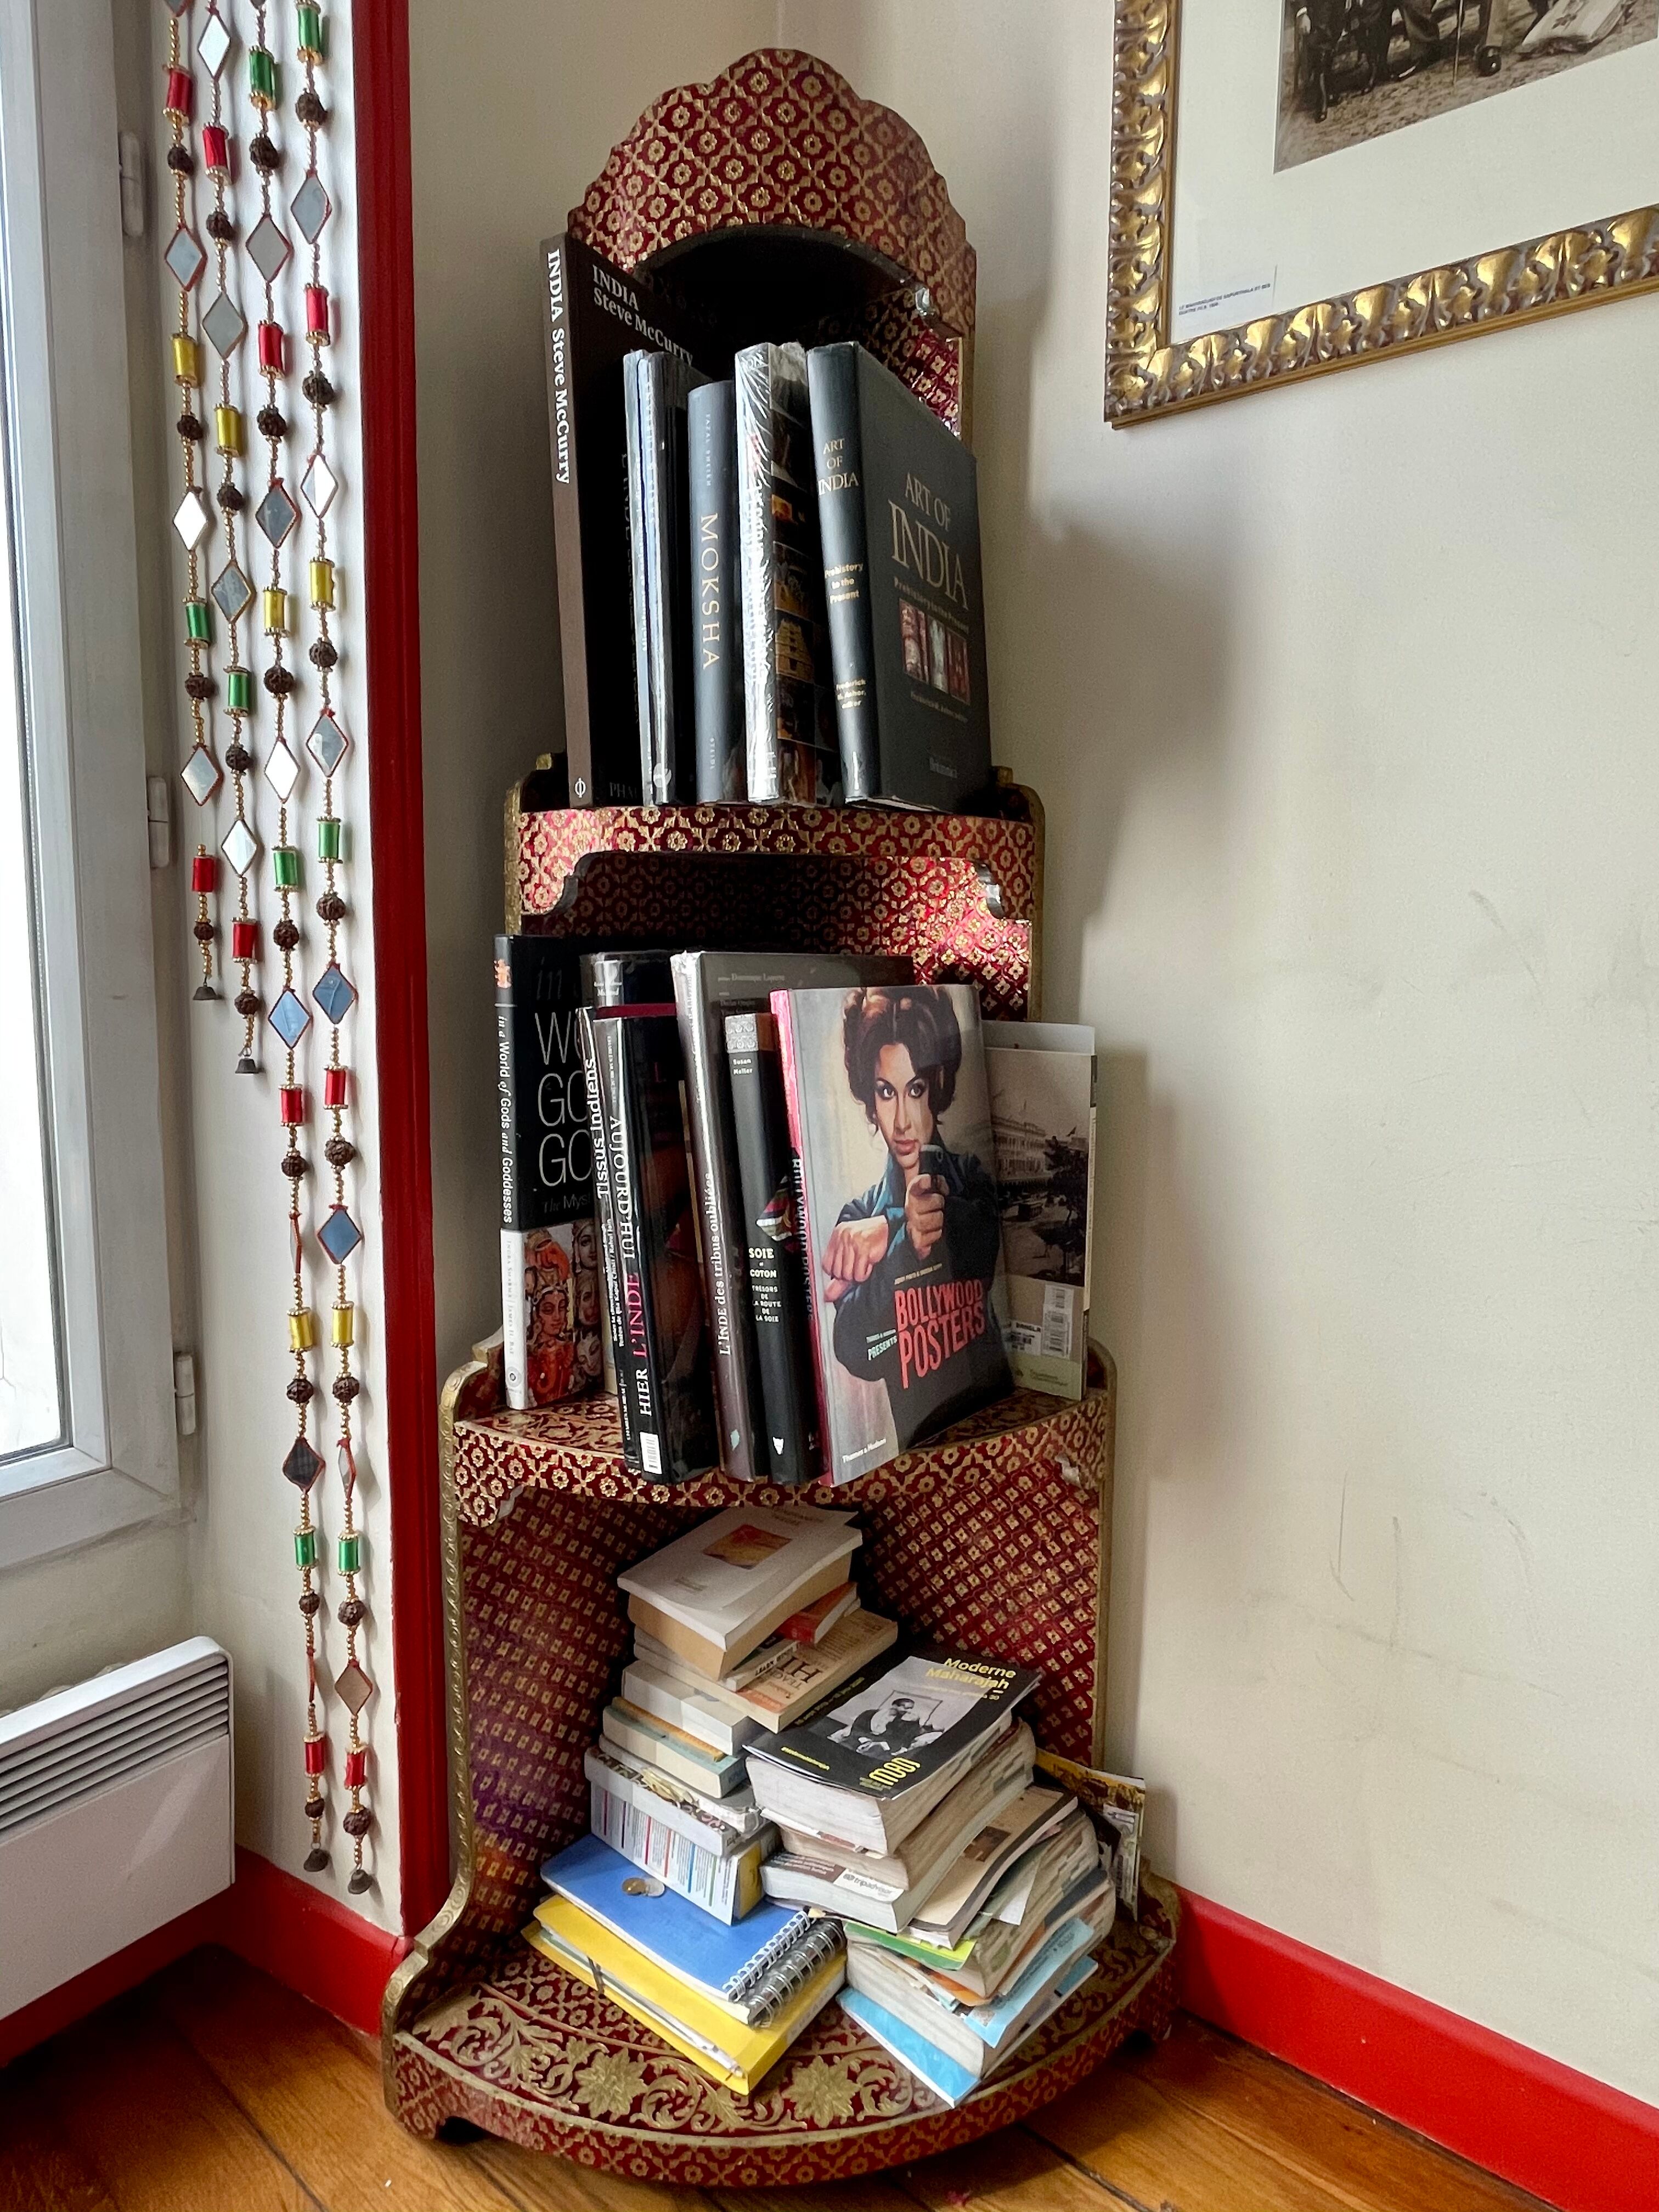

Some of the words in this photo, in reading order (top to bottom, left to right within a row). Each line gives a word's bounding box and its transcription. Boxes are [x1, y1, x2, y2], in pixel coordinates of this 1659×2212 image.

[548, 248, 563, 322] INDIA
[592, 264, 639, 311] INDIA
[594, 287, 633, 325] Steve
[635, 313, 693, 367] McCurry
[552, 328, 565, 386] Steve
[555, 388, 569, 484] McCurry
[823, 439, 845, 455] ART
[819, 472, 859, 496] INDIA
[826, 456, 843, 470] OF
[905, 472, 931, 517] ART
[934, 497, 951, 532] OF
[888, 499, 969, 611] INDIA
[701, 513, 720, 669] MOKSHA
[498, 1041, 510, 1077] World
[497, 1081, 512, 1094] of
[584, 1059, 604, 1133] indiens
[500, 1098, 513, 1129] Gods
[500, 1132, 513, 1154] and
[501, 1158, 515, 1223] Goddesses
[594, 1138, 610, 1199] Tissus
[610, 1116, 635, 1259] AUJOURD'HUI
[703, 1172, 719, 1232] oubliées
[709, 1235, 724, 1277] tribus
[748, 1248, 775, 1259] SOIE
[749, 1269, 777, 1278] COTON
[626, 1273, 647, 1358] L'INDE
[715, 1280, 726, 1305] des
[895, 1279, 984, 1330] BOLLYWOOD
[717, 1308, 731, 1356] L'INDE
[867, 1335, 898, 1361] PRESENTS
[898, 1300, 986, 1389] POSTERS
[635, 1368, 652, 1417] HIER
[925, 1667, 1009, 1690] Maharajah
[944, 1658, 1016, 1679] Moderne
[854, 1876, 893, 1895] tripadvisor
